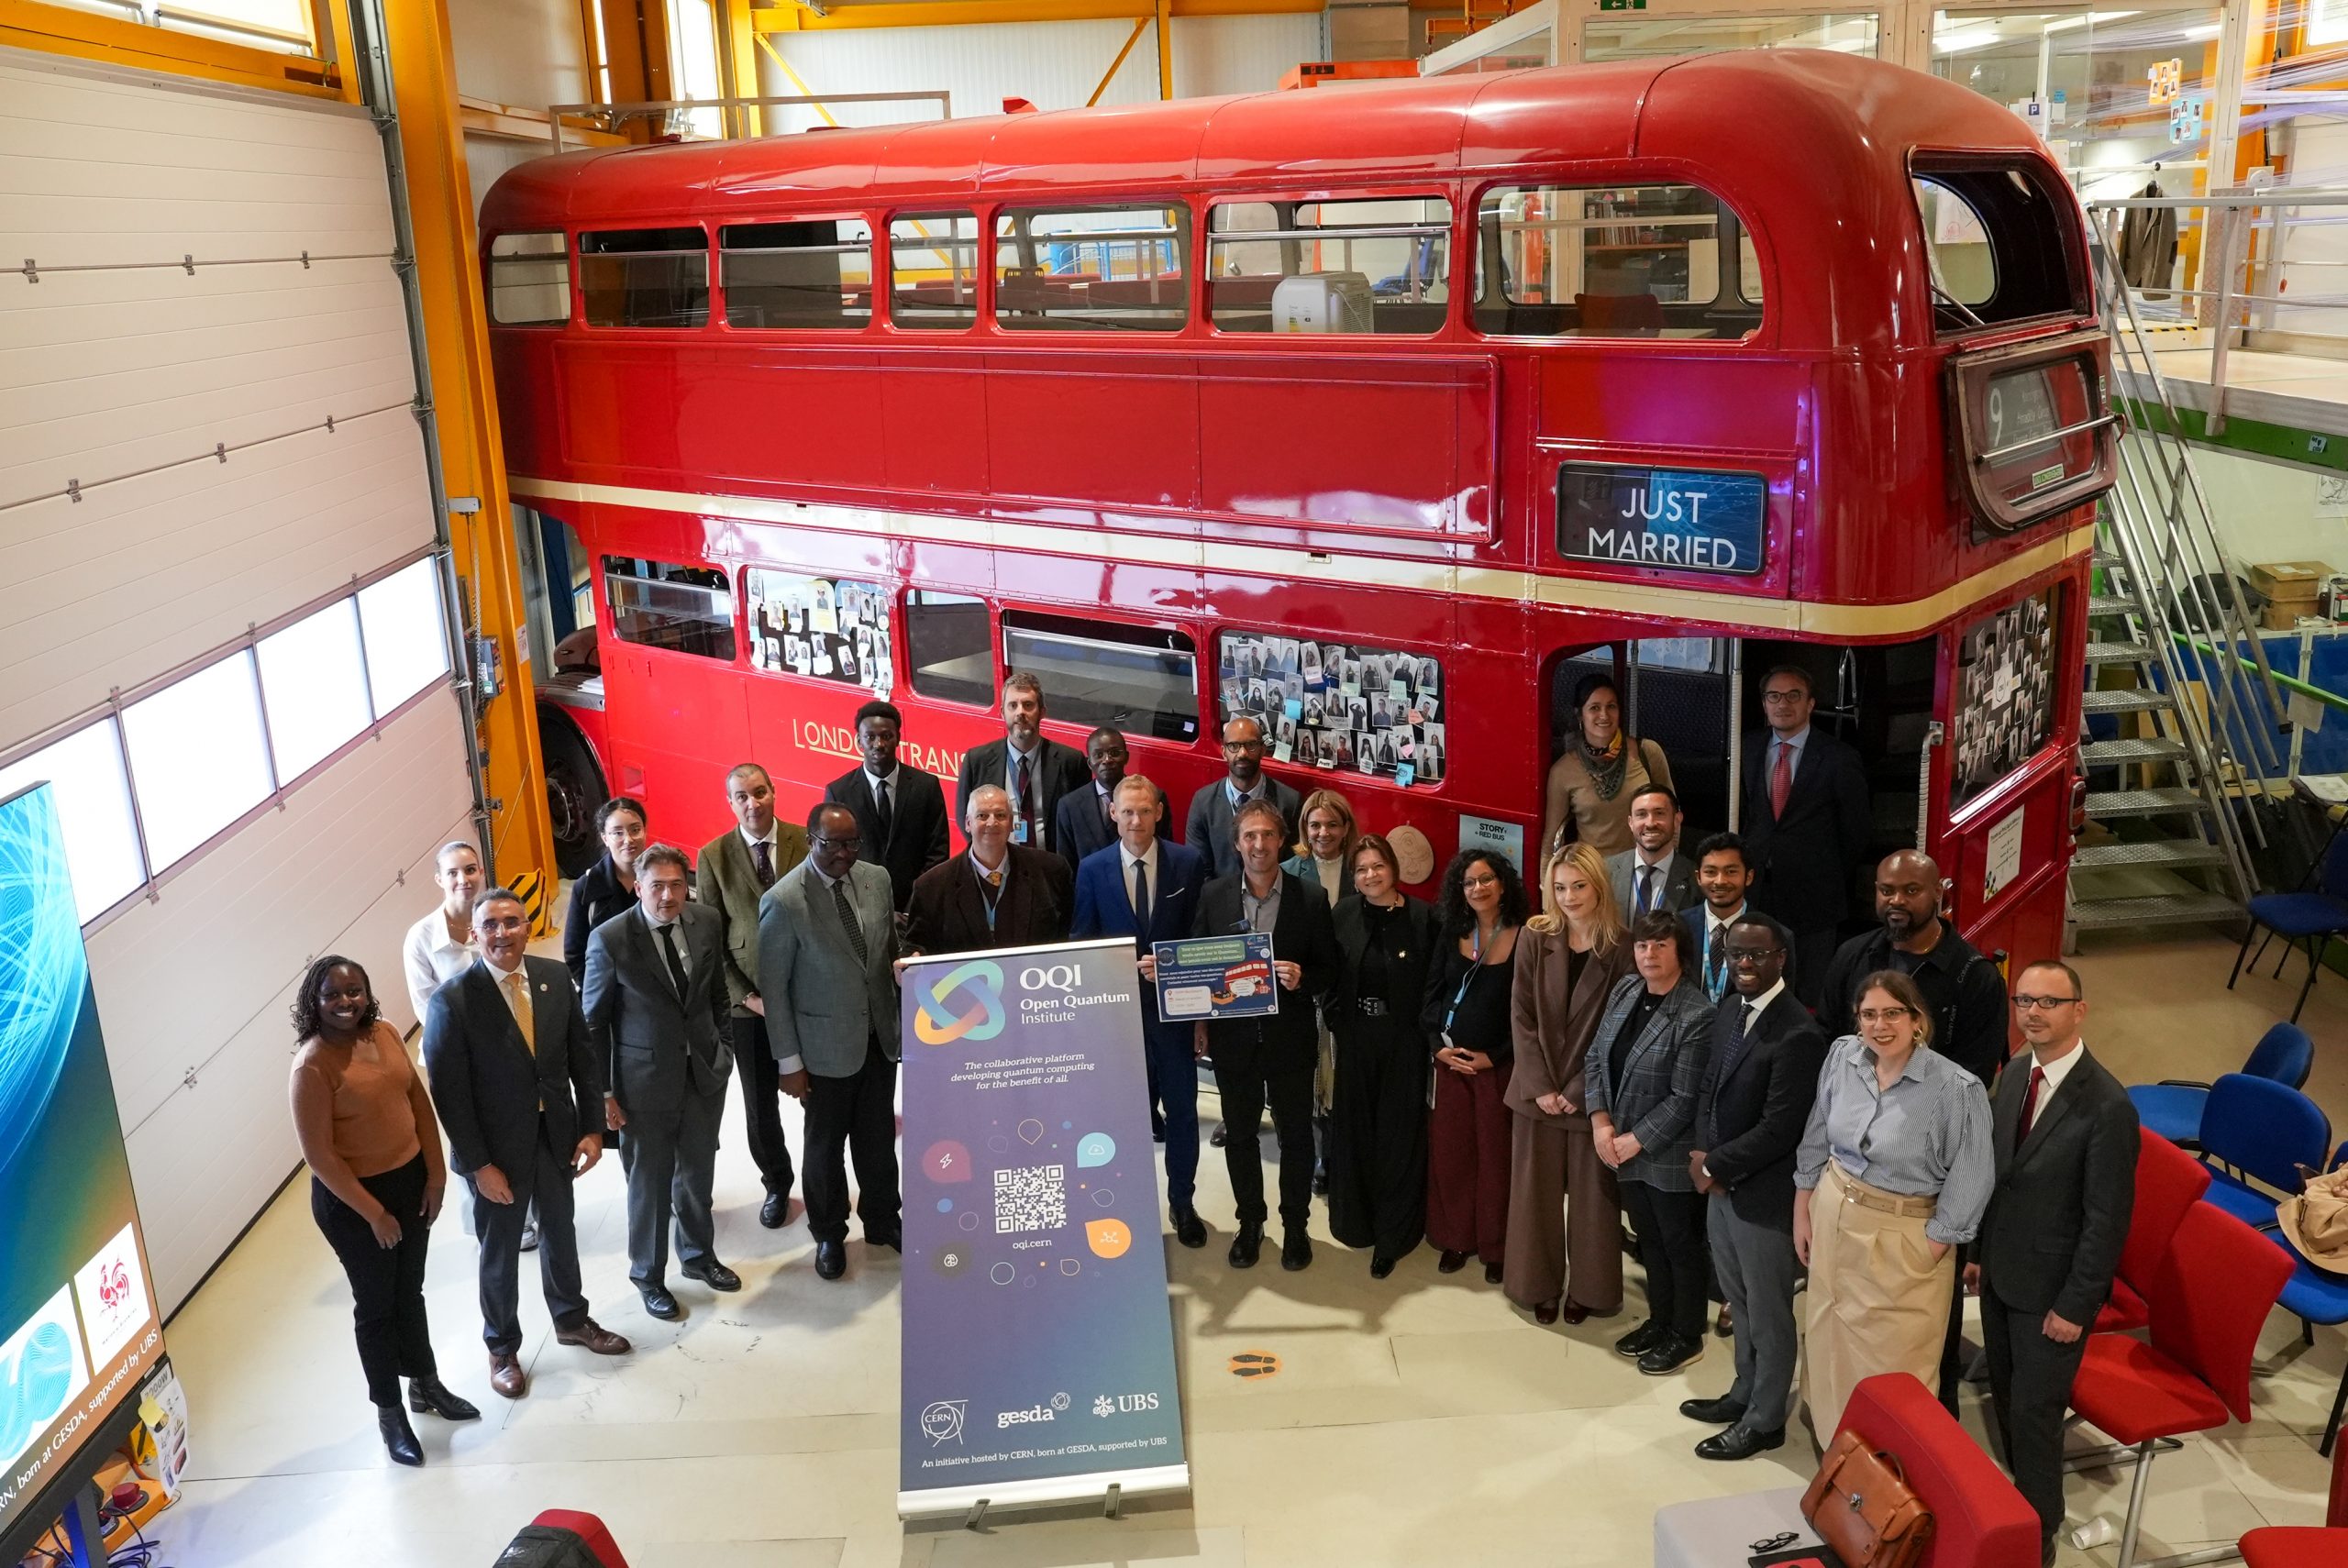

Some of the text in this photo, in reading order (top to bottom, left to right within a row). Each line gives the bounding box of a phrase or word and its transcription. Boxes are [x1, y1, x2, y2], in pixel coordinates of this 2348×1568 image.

[1989, 387, 2003, 447] 9
[1622, 488, 1708, 524] JUST
[1588, 526, 1737, 569] MARRIED
[792, 718, 865, 757] LOND
[1479, 823, 1505, 834] STORY
[1479, 831, 1505, 841] RED BUS
[1019, 964, 1082, 993] OQI
[1020, 992, 1131, 1013] Open Quantum
[1021, 1010, 1076, 1024] Institute
[950, 1062, 1095, 1082] developing quantum computing
[964, 1053, 1085, 1071] The collaborative platform
[976, 1074, 1070, 1090] for the benefit of all.
[1012, 1238, 1053, 1250] oqi.cern
[17, 1460, 41, 1490] born
[42, 1446, 52, 1463] at
[52, 1409, 88, 1450] GESDA,
[88, 1360, 128, 1412] supported
[128, 1351, 139, 1367] by
[139, 1329, 158, 1354] UBS
[1117, 1392, 1160, 1412] UBS
[924, 1412, 952, 1423] CERN
[997, 1404, 1055, 1429] gesda
[922, 1436, 1168, 1468] An initiative hosted by CERN, born at GESDA, supported by UBS
